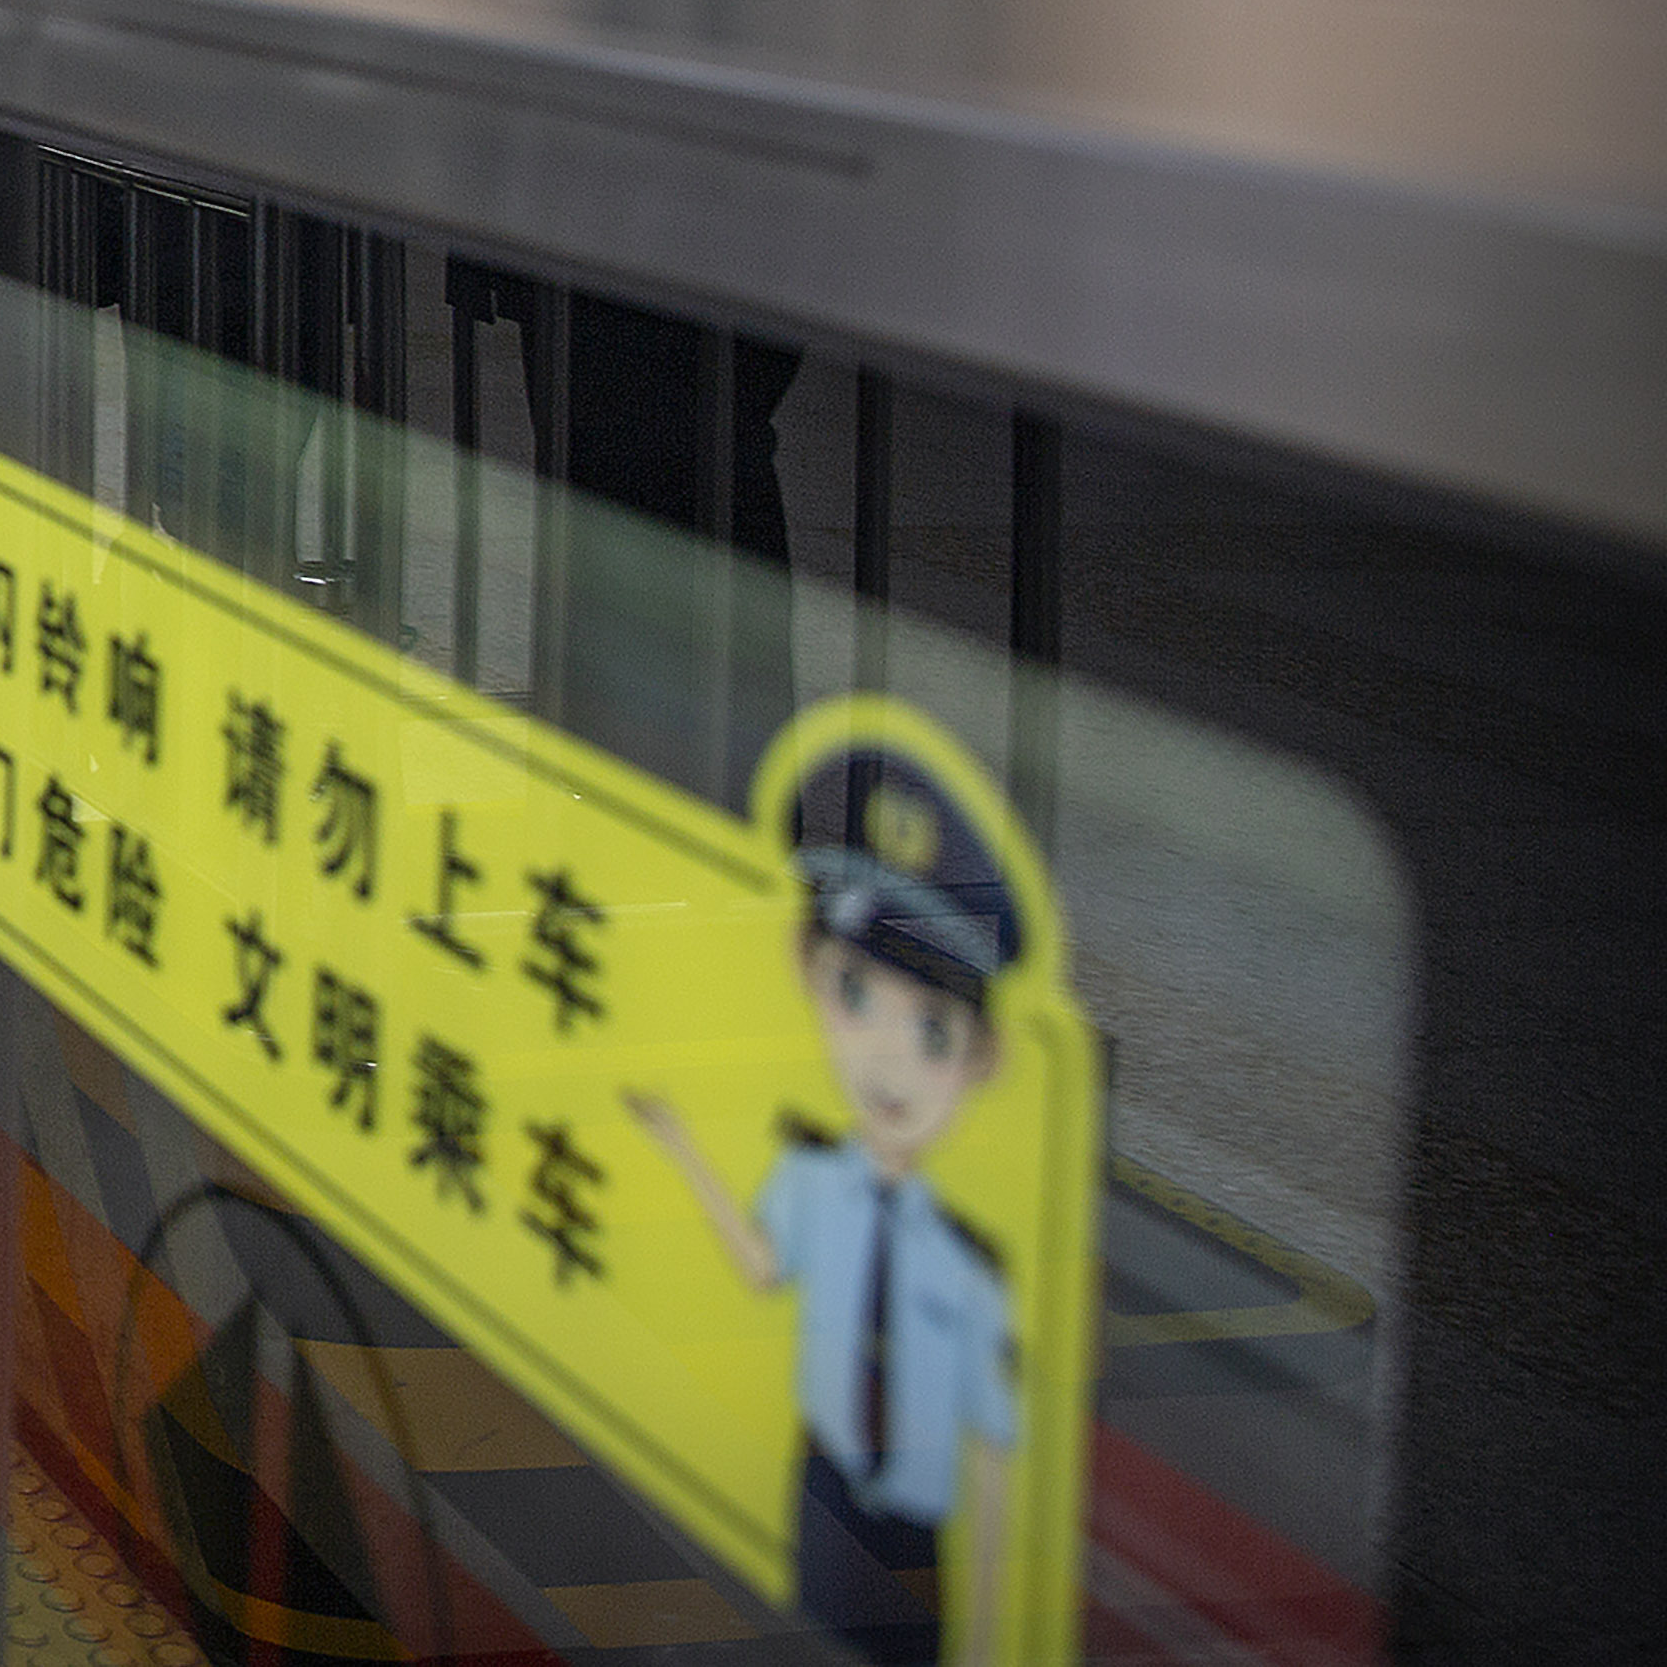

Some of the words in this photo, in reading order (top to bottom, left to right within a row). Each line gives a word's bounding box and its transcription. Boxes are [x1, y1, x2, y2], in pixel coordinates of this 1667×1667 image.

[221, 686, 611, 1037] 请勿上车
[219, 906, 611, 1294] 文明乘车
